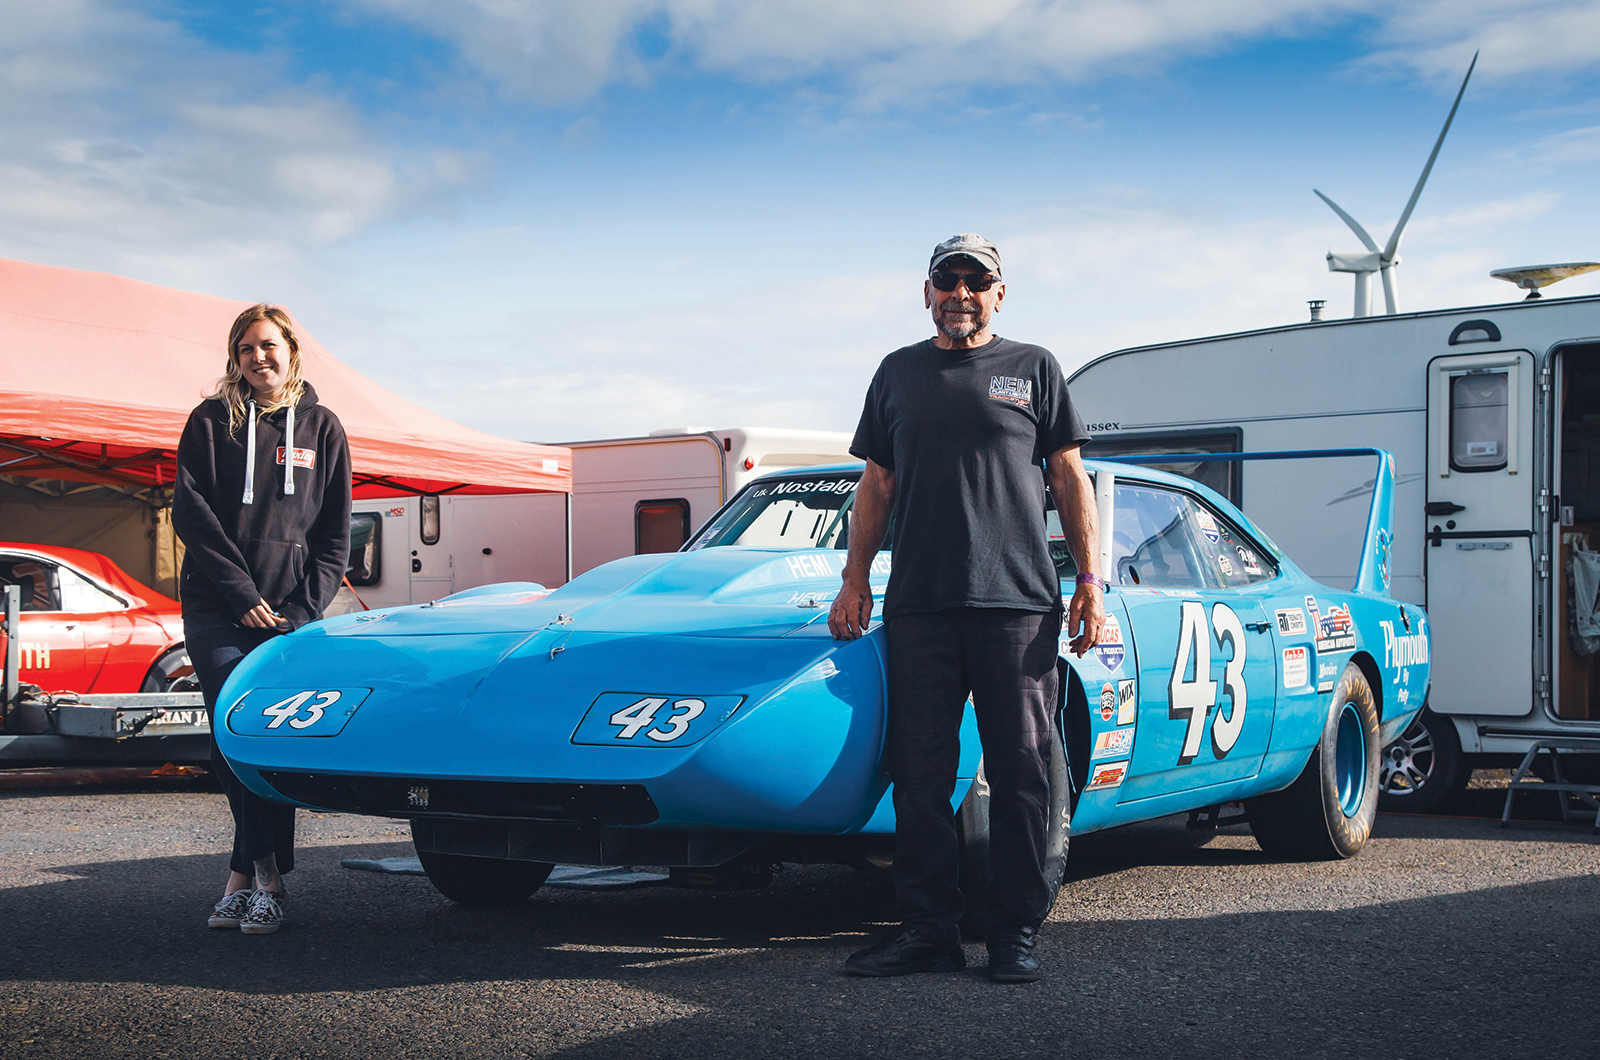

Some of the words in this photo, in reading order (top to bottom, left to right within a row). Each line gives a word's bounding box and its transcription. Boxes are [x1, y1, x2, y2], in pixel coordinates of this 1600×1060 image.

[990, 375, 1031, 393] NEM
[389, 506, 405, 515] MSD
[785, 553, 834, 579] HEMI
[1099, 628, 1119, 643] UCAS
[1379, 618, 1429, 684] Plymouth
[1118, 680, 1134, 706] WIX
[1168, 600, 1247, 766] 43
[262, 690, 342, 730] 43
[608, 696, 707, 743] 43
